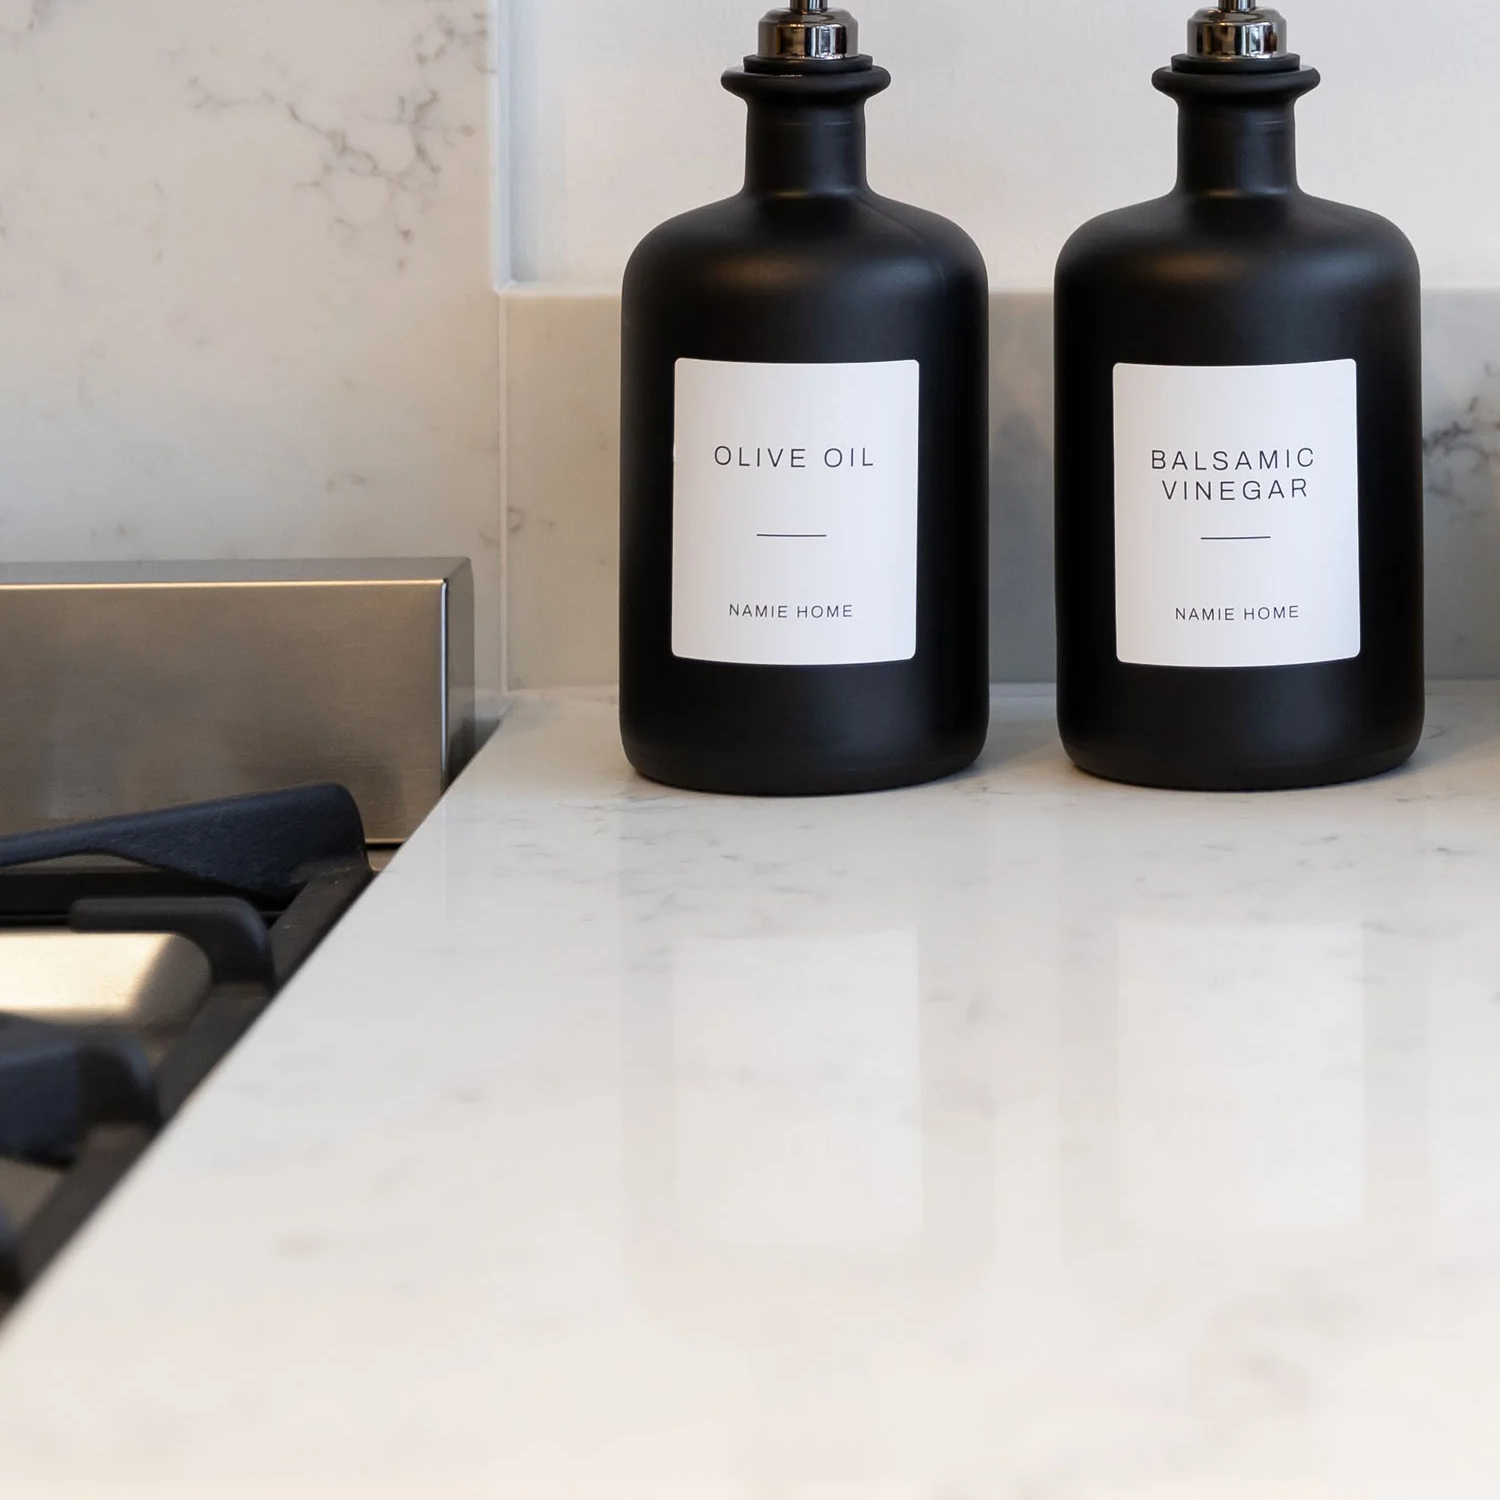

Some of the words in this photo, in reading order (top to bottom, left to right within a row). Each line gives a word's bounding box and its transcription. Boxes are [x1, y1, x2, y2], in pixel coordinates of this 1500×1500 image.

[714, 445, 806, 468] OLIVE
[823, 447, 875, 468] OIL
[1151, 447, 1315, 471] BALSAMIC
[1161, 478, 1308, 501] VINEGAR
[729, 603, 788, 619] NAMIE
[796, 604, 853, 619] HOME
[1175, 607, 1235, 621] NAMIE
[1243, 605, 1299, 621] HOME
